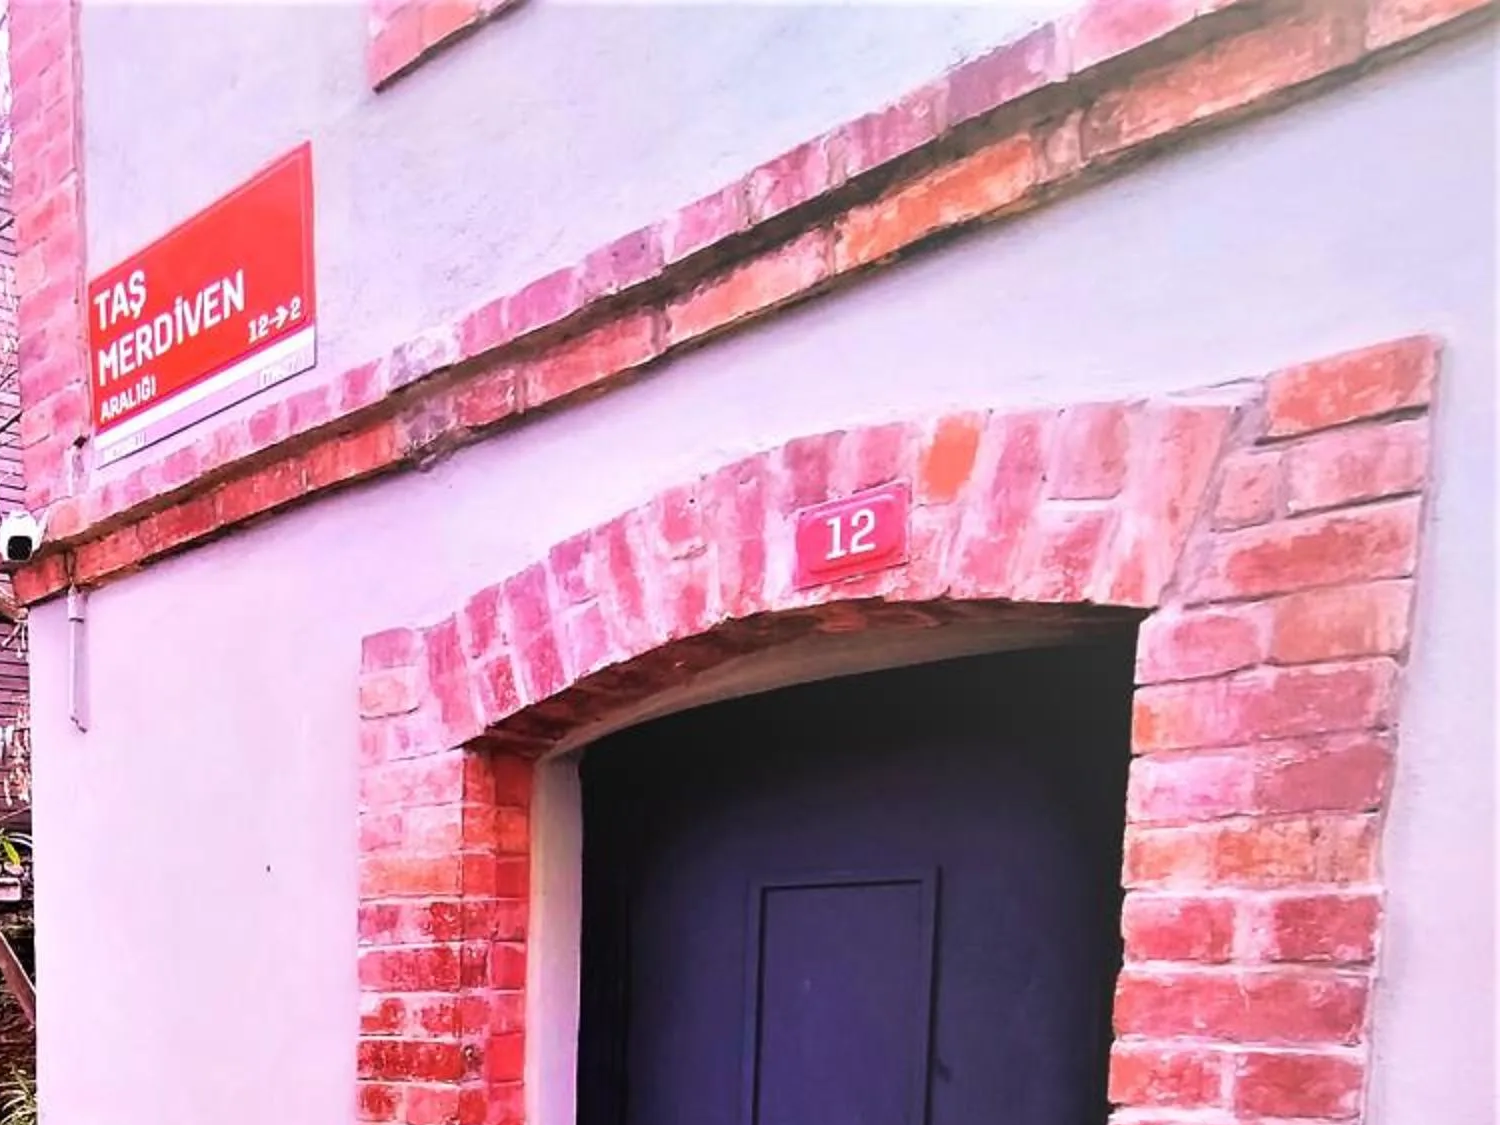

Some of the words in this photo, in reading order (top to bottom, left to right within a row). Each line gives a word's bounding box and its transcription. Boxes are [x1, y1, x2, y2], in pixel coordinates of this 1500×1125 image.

[93, 270, 147, 331] TAŞ
[98, 268, 245, 387] MERDİVEN
[825, 508, 876, 561] 12
